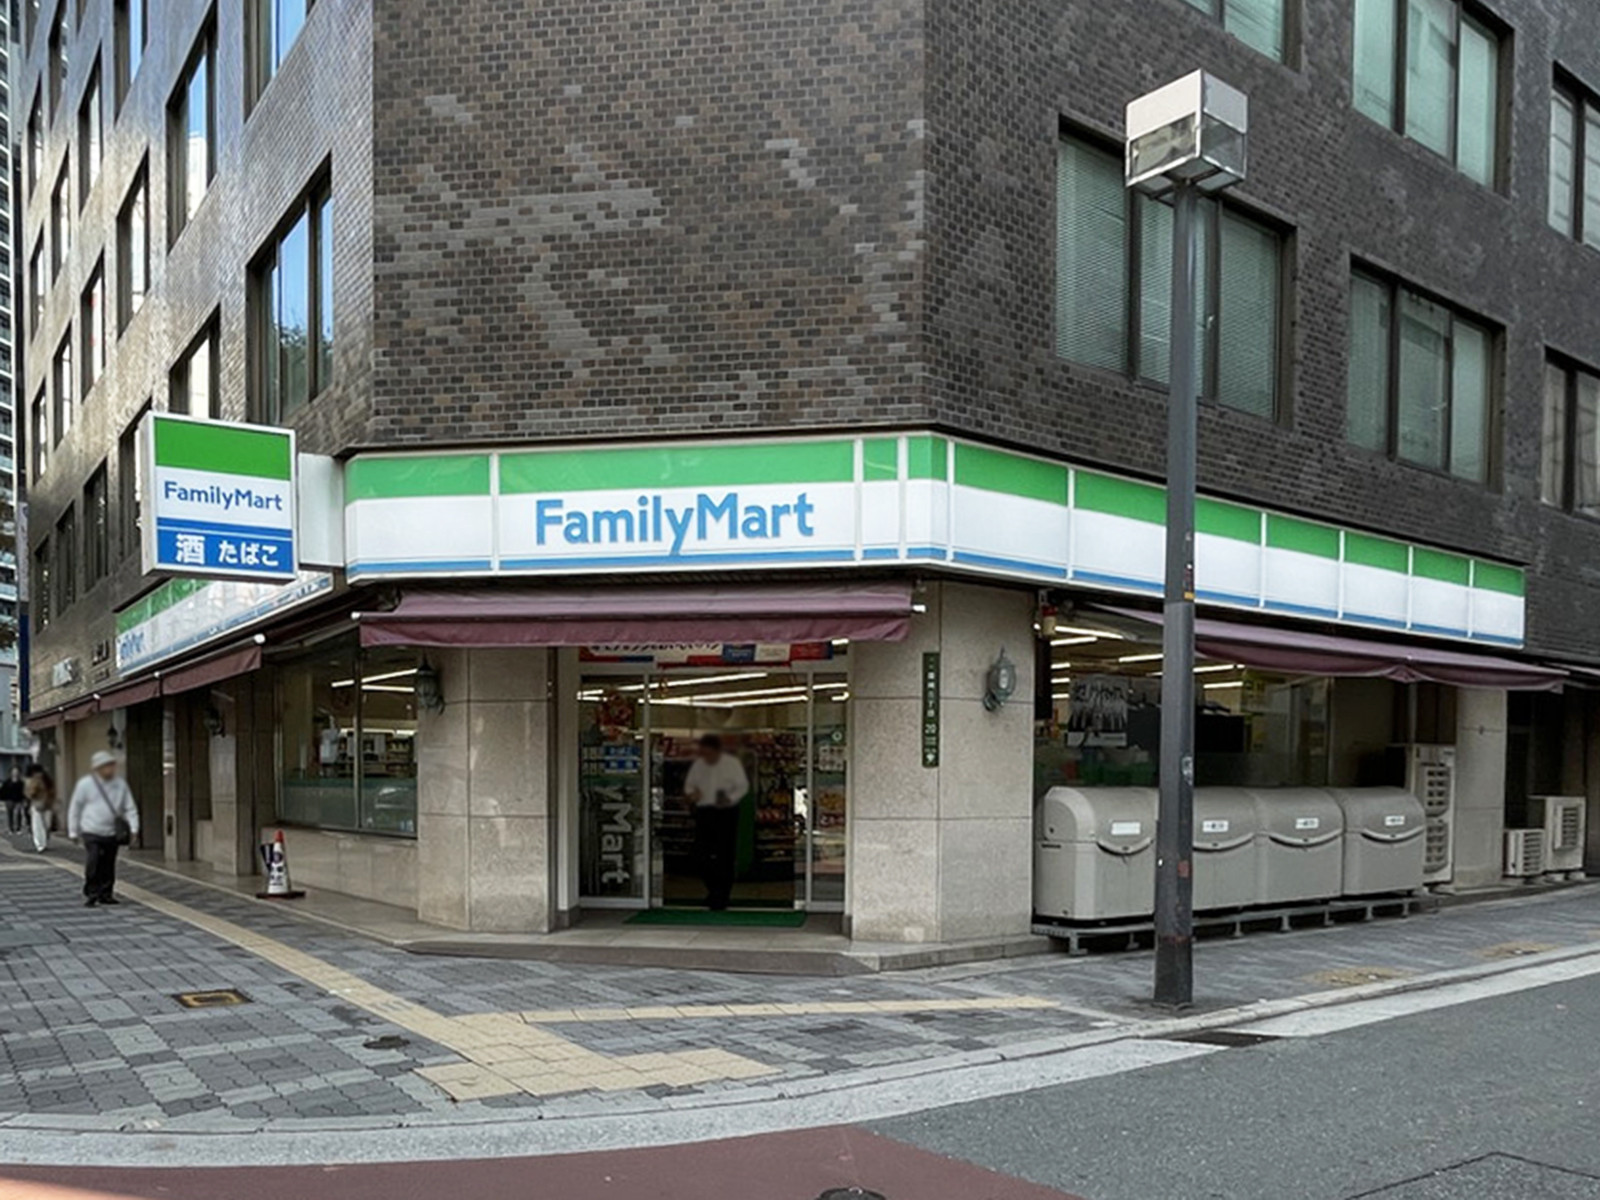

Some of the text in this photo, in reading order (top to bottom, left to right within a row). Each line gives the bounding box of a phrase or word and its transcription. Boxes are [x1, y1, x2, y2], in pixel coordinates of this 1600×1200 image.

[164, 481, 283, 511] FamilyMart
[536, 492, 814, 556] FamilyMart
[175, 533, 279, 567] 酒 たばこ
